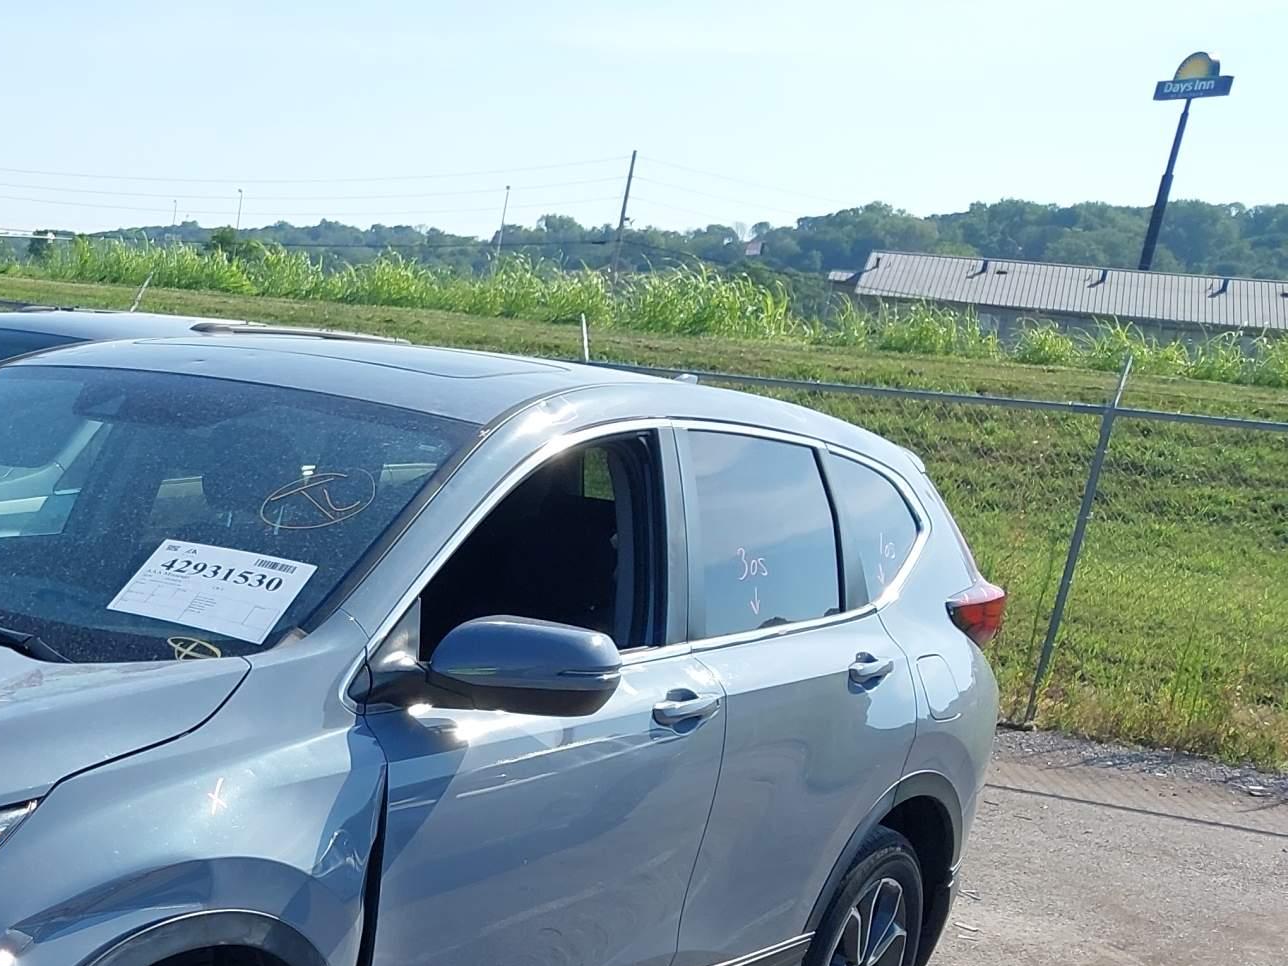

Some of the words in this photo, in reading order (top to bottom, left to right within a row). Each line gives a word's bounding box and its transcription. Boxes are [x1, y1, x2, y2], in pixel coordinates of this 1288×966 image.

[1163, 82, 1193, 93] Days
[1194, 80, 1216, 91] Inn
[160, 558, 284, 592] 42931530
